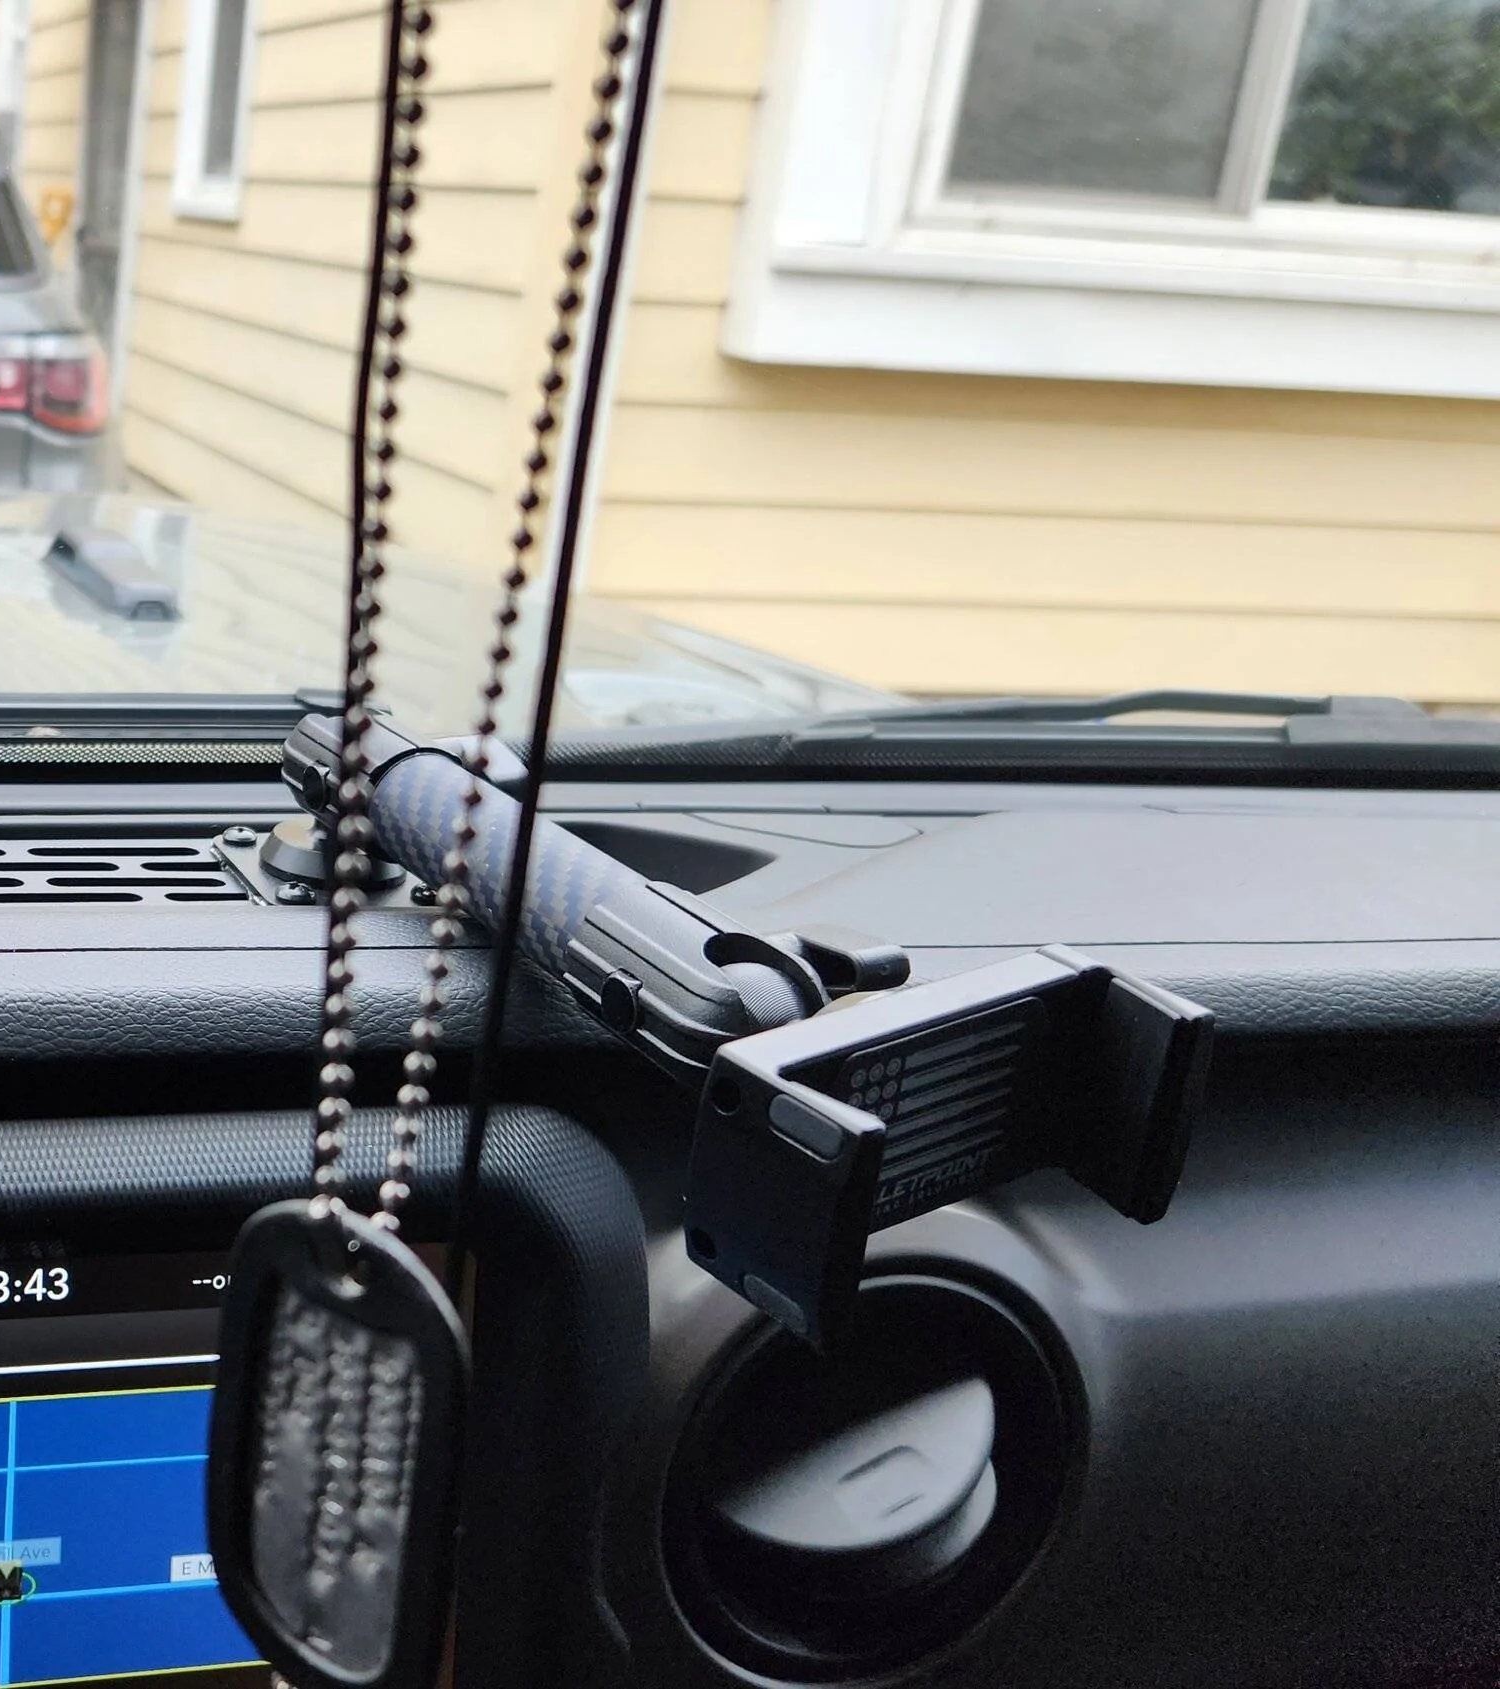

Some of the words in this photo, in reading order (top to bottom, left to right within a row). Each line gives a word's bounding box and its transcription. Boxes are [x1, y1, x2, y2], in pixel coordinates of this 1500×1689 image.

[876, 1148, 994, 1203] LETPOINT
[21, 1545, 51, 1560] Ave
[182, 1560, 192, 1576] E
[198, 1559, 214, 1574] M
